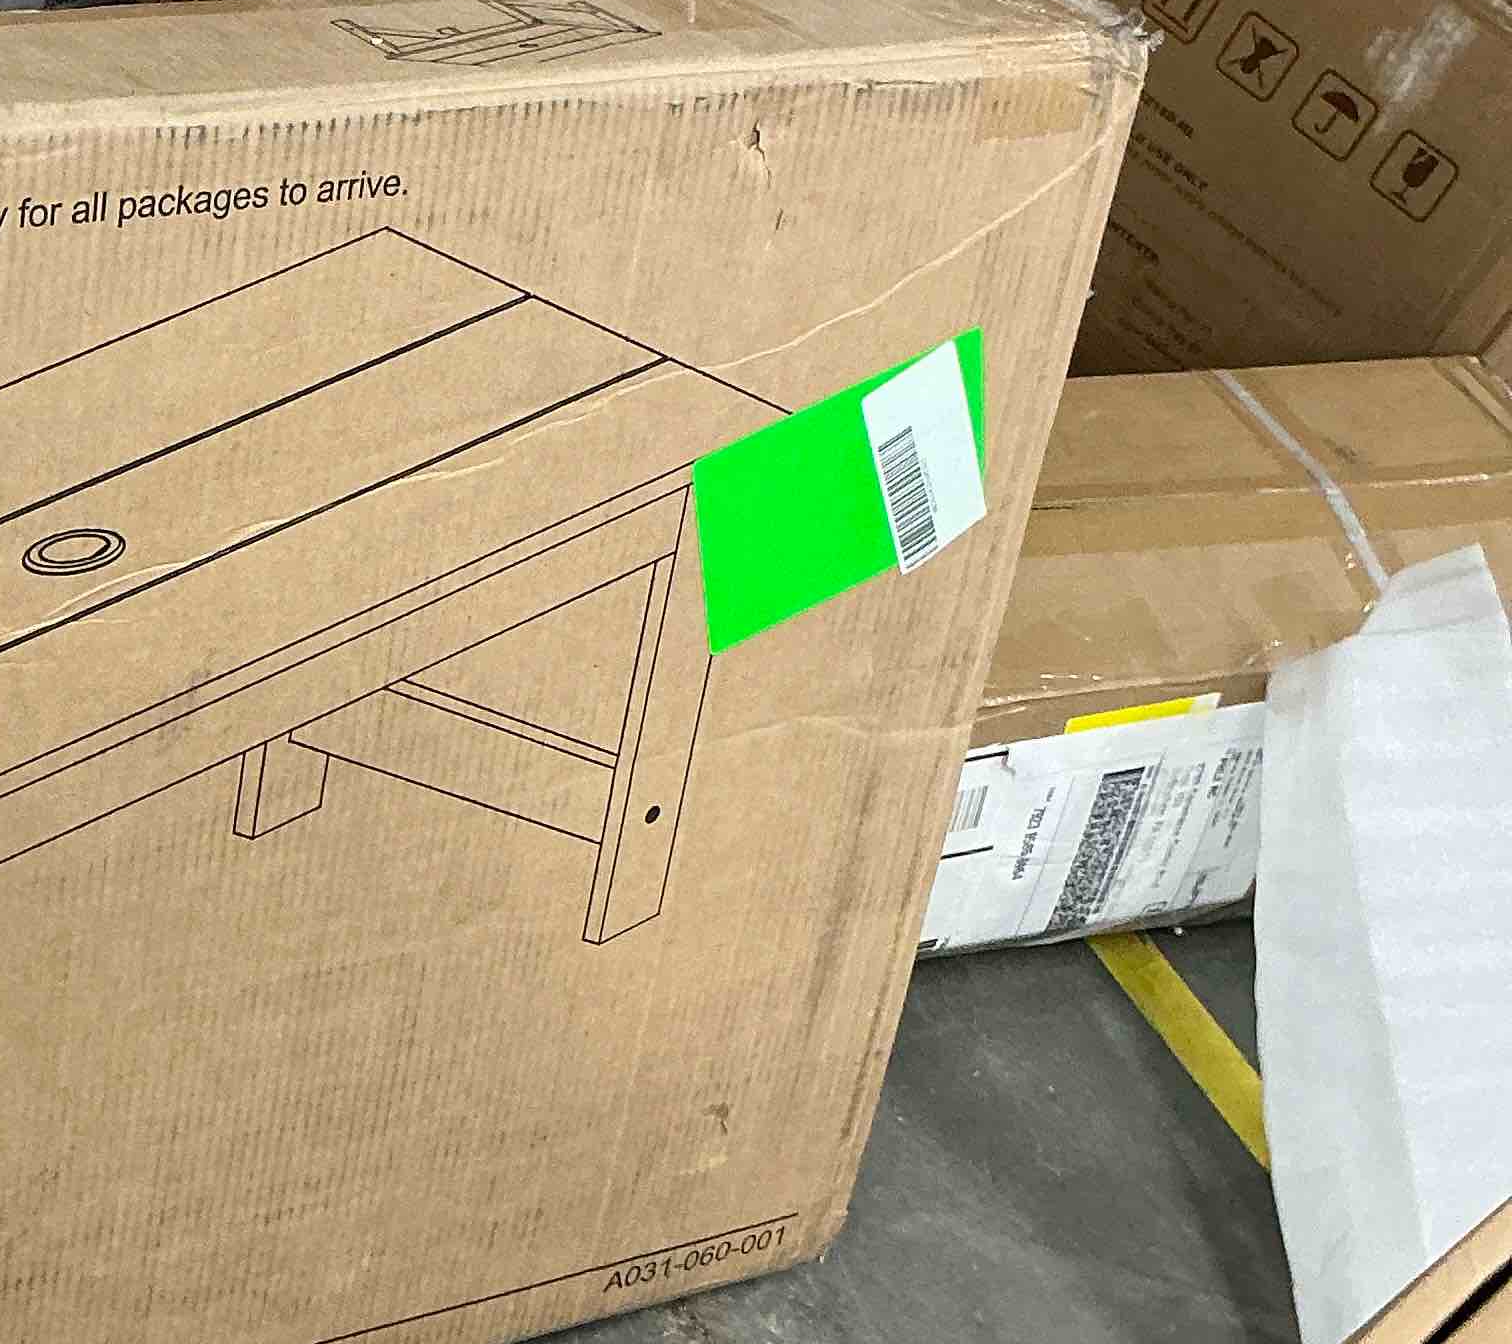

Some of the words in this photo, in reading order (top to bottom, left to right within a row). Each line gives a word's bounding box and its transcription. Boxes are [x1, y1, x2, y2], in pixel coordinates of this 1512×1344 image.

[17, 195, 63, 230] for
[70, 189, 109, 224] all
[117, 183, 271, 232] packages
[278, 178, 308, 208] to
[316, 167, 409, 203] arrive.
[603, 1225, 786, 1293] A031-060-001
